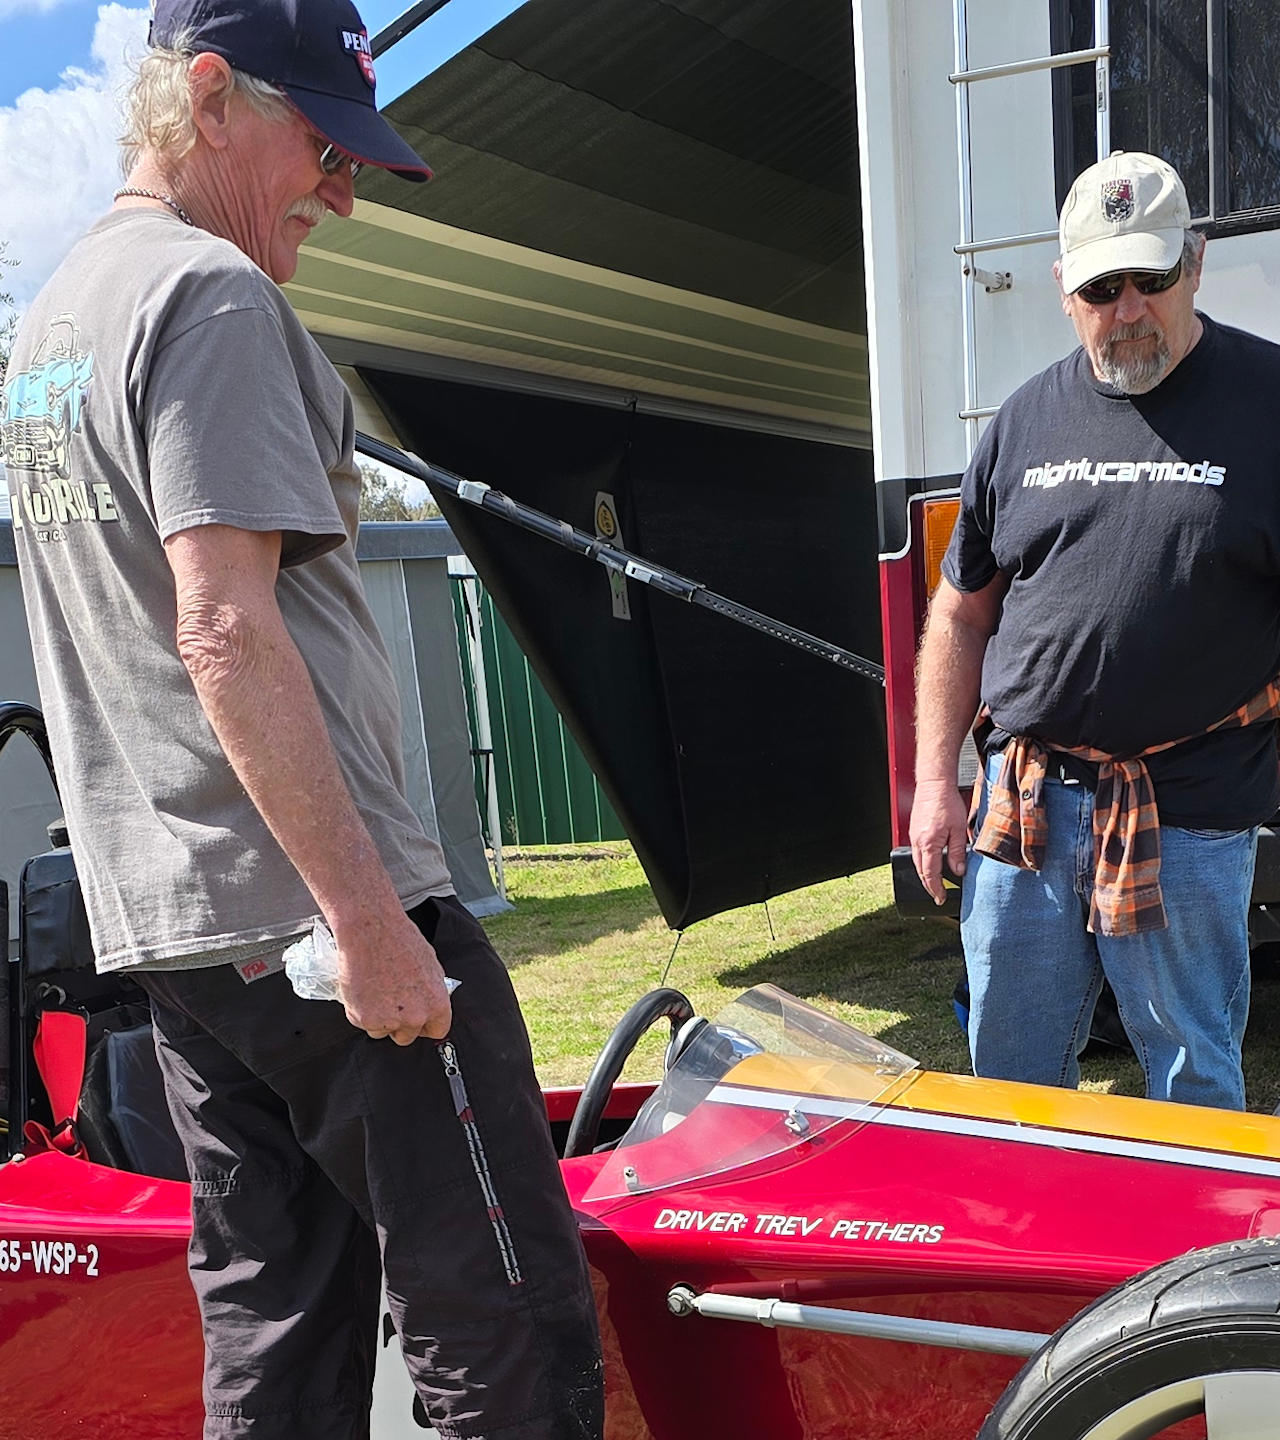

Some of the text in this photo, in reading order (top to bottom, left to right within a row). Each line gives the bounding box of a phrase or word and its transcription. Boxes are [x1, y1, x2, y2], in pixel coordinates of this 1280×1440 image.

[1022, 457, 1227, 489] mightycarmods
[654, 1208, 945, 1244] DRIVER: TREV PETHERS
